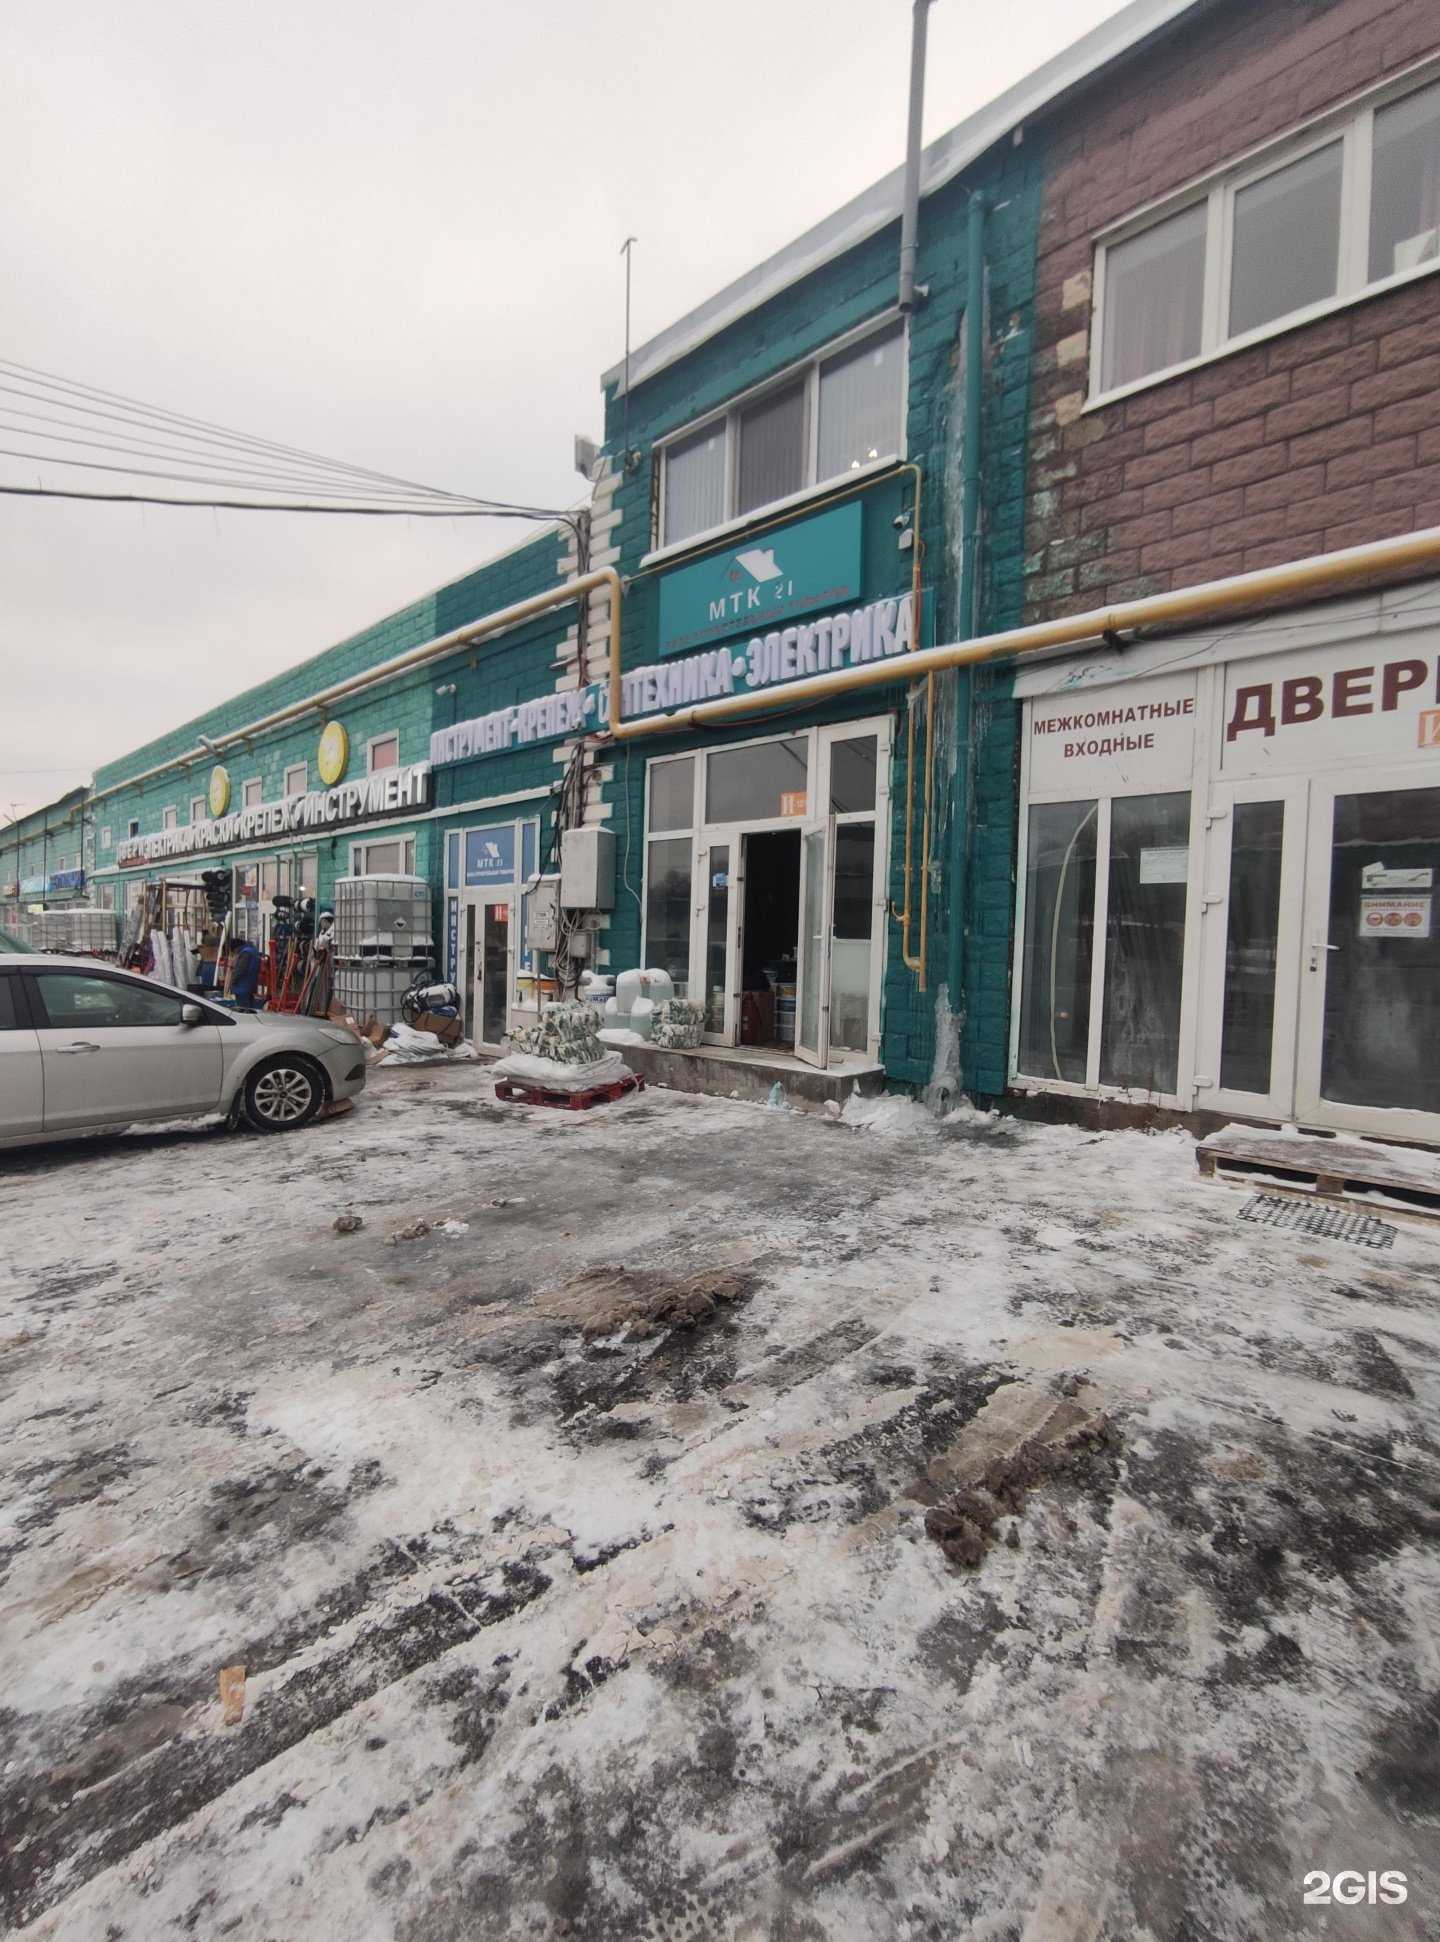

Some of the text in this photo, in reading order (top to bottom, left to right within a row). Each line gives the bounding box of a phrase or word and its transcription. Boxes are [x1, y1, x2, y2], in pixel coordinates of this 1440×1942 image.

[709, 586, 760, 621] МТК
[598, 647, 734, 723] СНТЕХНИКА
[745, 595, 914, 688] ЭЛЕКТРИКА
[1034, 698, 1194, 735] МЕЖКОМНАТНЫЕ
[1064, 733, 1155, 758] ВХОДНЫЕ
[240, 799, 298, 840] КРЕПЕЖ
[303, 768, 428, 826] ИНСТРУМЕНТ
